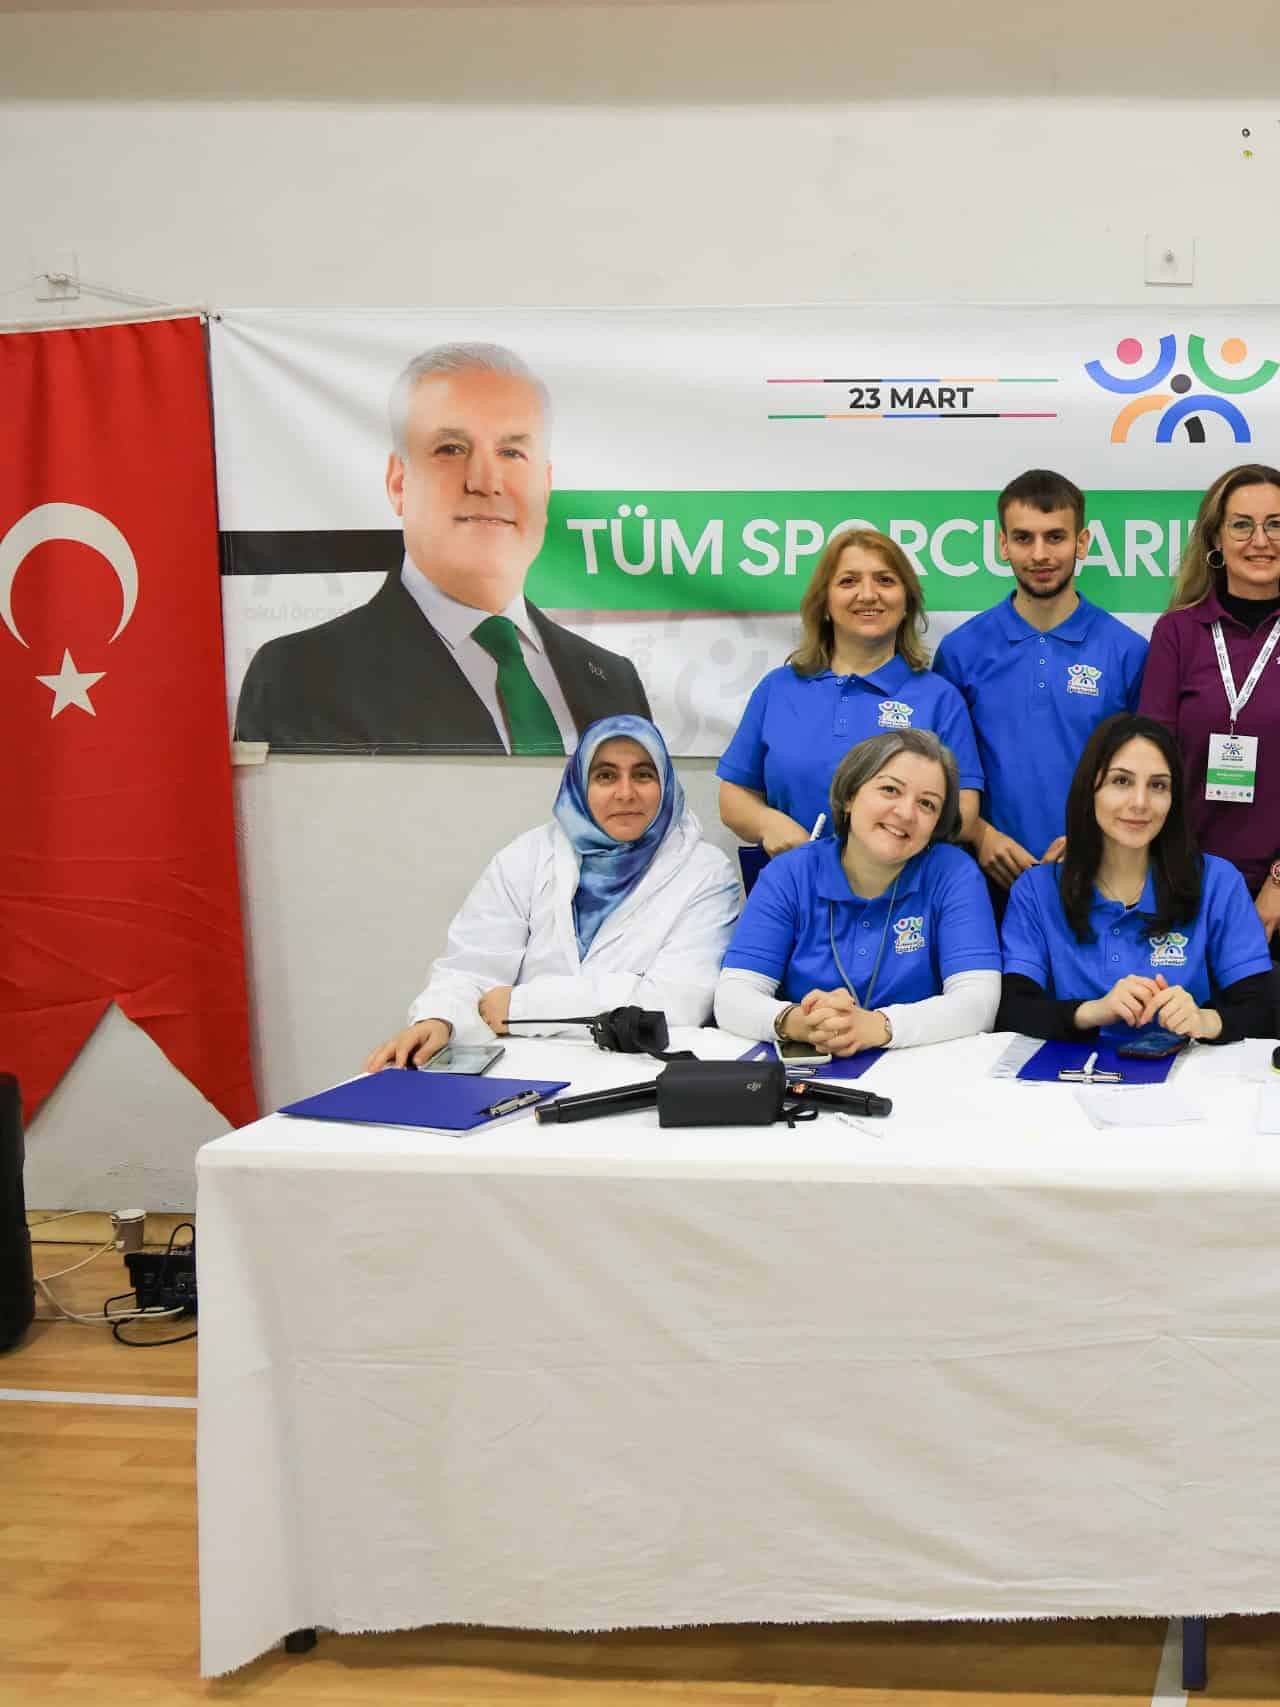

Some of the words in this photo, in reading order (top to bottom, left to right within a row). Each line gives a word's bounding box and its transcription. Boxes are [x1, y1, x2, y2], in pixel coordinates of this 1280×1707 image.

[848, 388, 881, 409] 23
[890, 387, 975, 409] MART
[566, 504, 724, 576] TÜM
